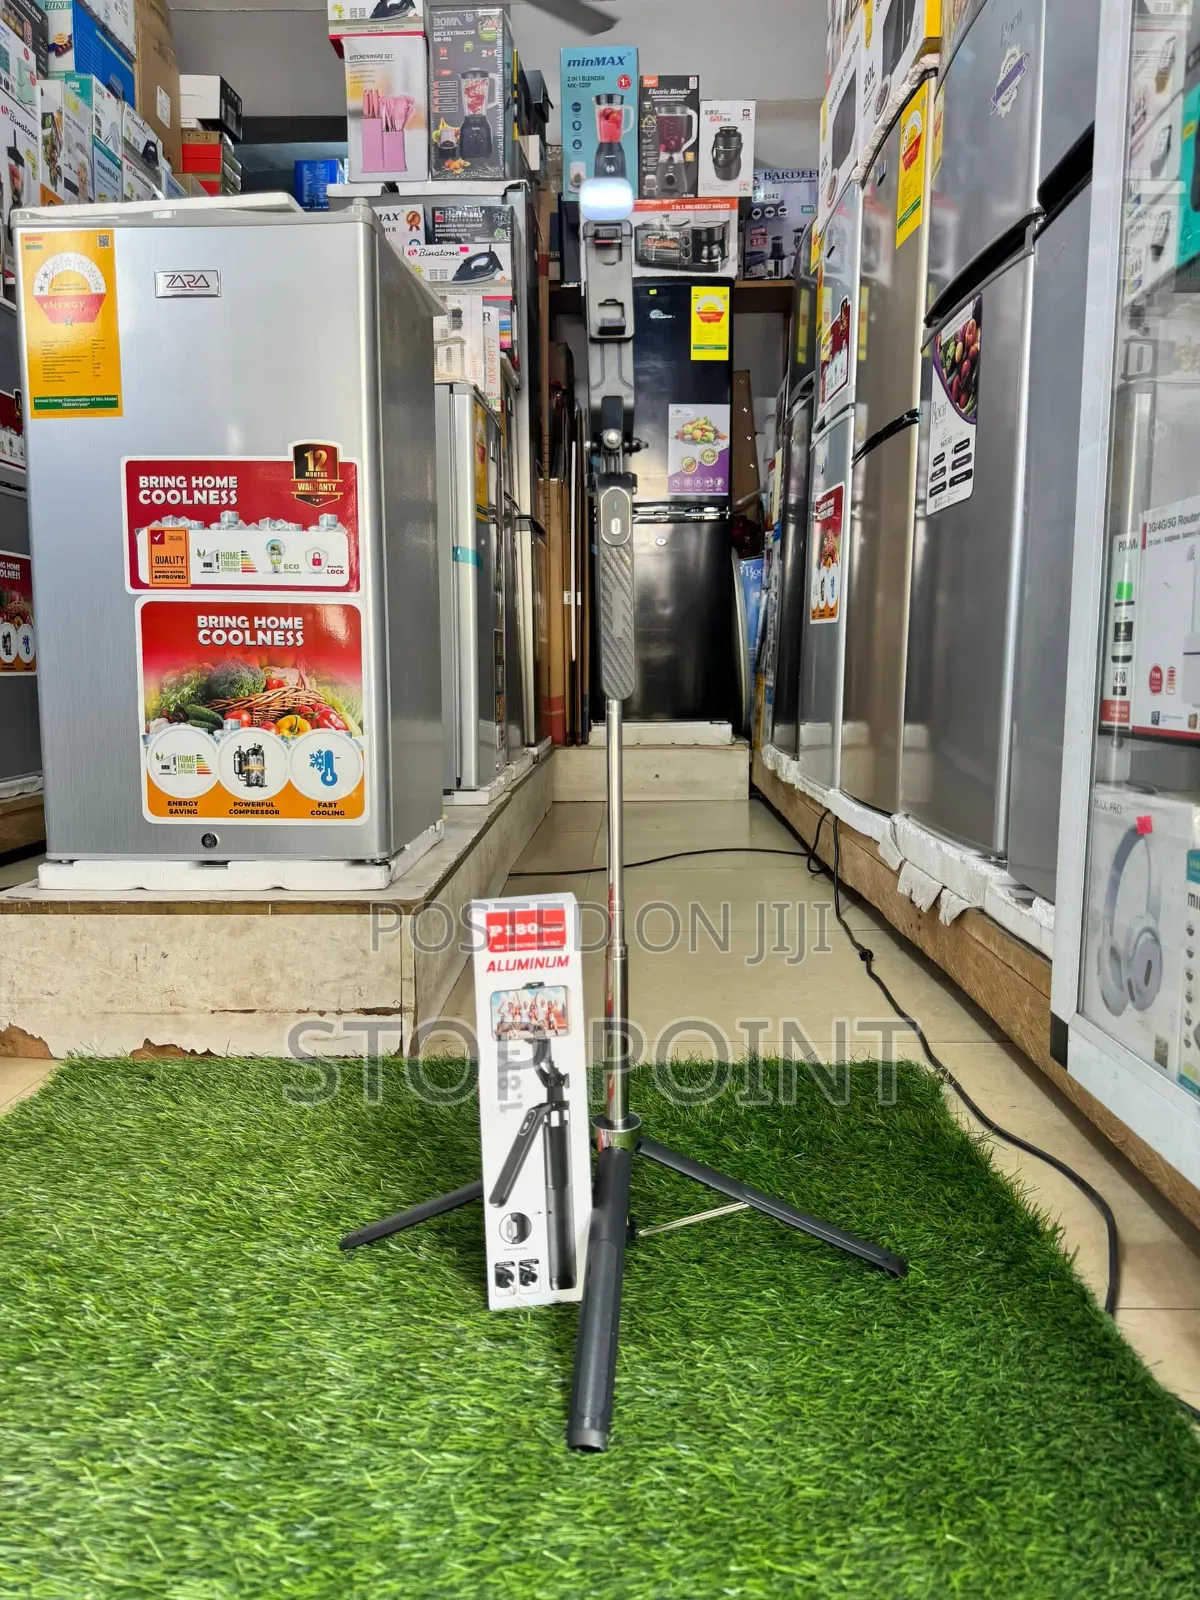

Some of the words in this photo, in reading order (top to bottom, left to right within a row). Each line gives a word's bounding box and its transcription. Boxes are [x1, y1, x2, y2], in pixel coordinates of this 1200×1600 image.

[567, 56, 627, 67] minMAX
[418, 247, 461, 257] Binatone
[164, 274, 211, 289] ZARA
[304, 450, 328, 472] 12
[138, 475, 187, 489] BRING
[191, 475, 238, 489] HOME
[138, 489, 238, 505] COOLNESS
[1178, 512, 1200, 525] Router
[155, 555, 185, 565] QUALITY
[220, 551, 240, 560] HOME
[196, 615, 250, 630] BRING
[253, 616, 304, 630] HOME
[197, 629, 305, 647] COOLNESS
[178, 755, 196, 763] HOME
[167, 800, 199, 808] ENERGY
[486, 954, 570, 973] ALUMINUM
